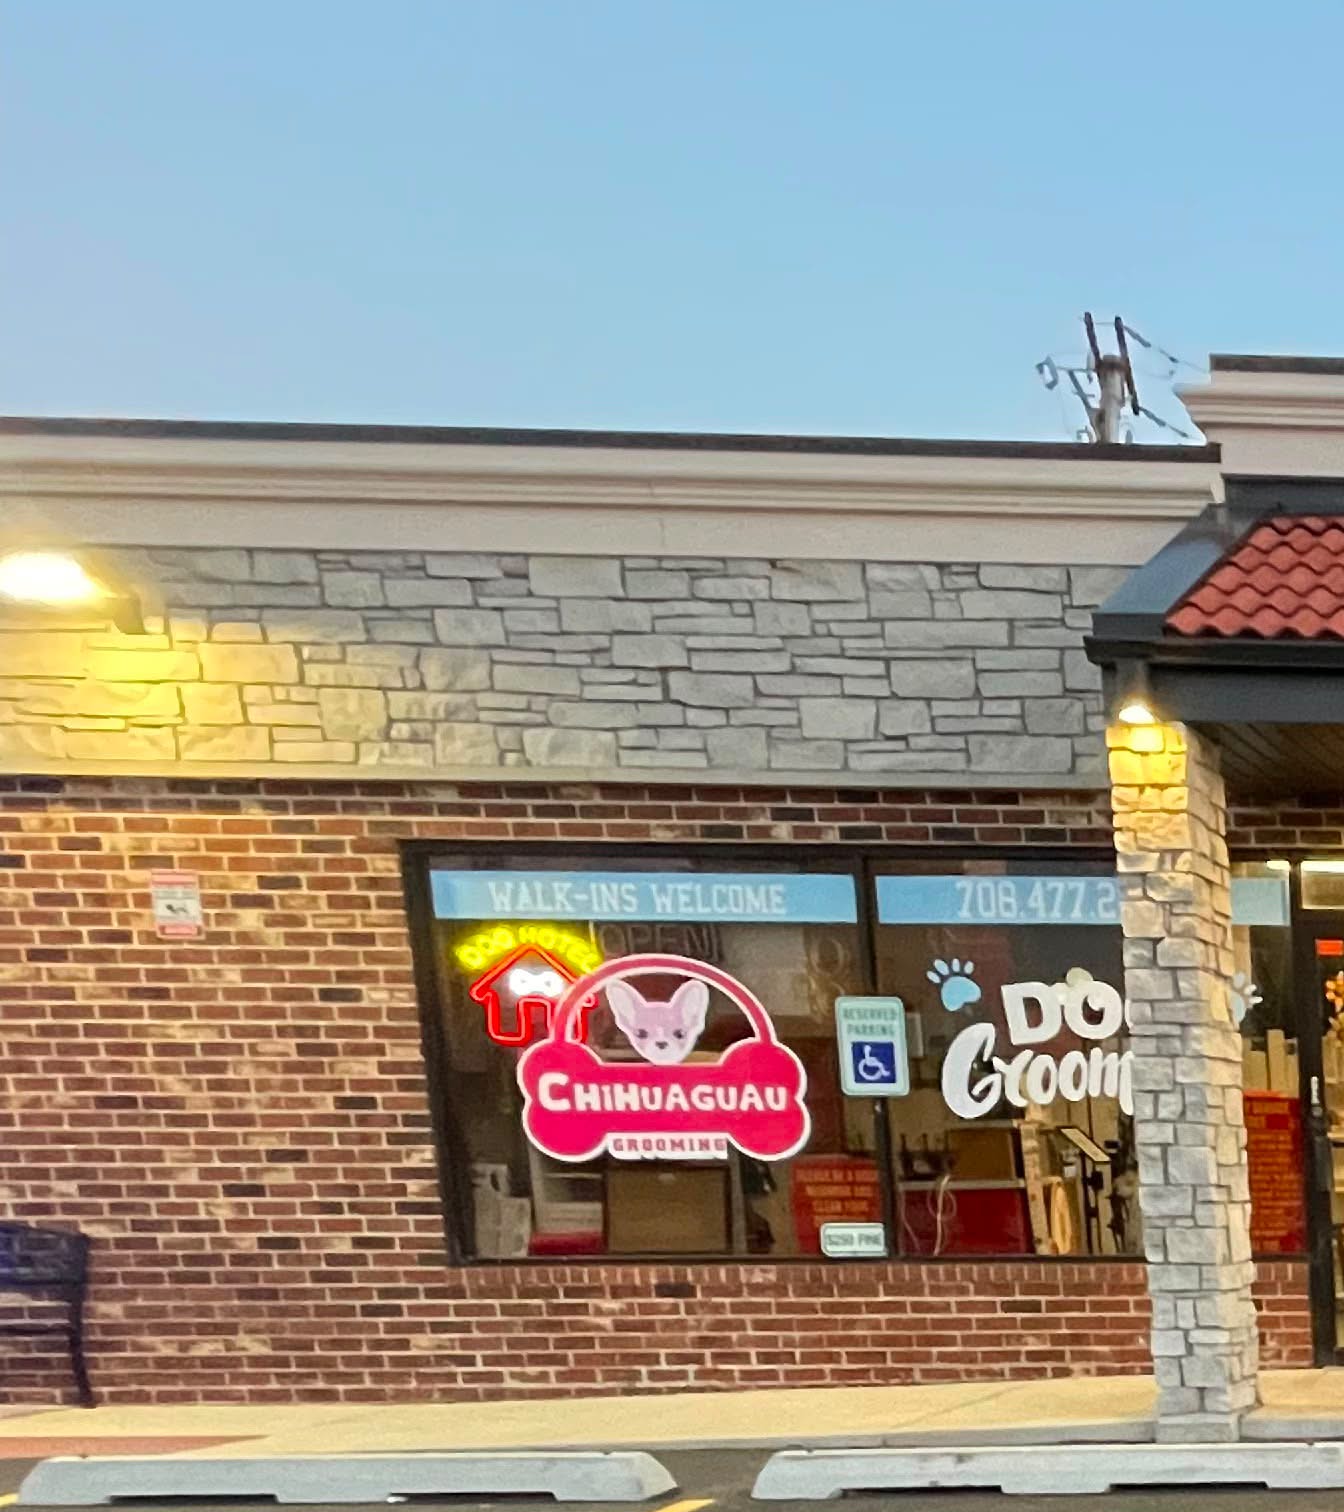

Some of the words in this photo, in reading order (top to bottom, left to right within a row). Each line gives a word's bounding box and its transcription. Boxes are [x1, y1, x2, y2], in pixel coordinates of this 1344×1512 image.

[487, 880, 638, 914] WALK-INS
[649, 882, 788, 916] WELCOME
[454, 924, 515, 970] DOG
[842, 1006, 898, 1022] RESERVED
[1001, 978, 1134, 1046] DO
[846, 1023, 896, 1037] PARKING
[612, 1138, 728, 1152] GROOMING
